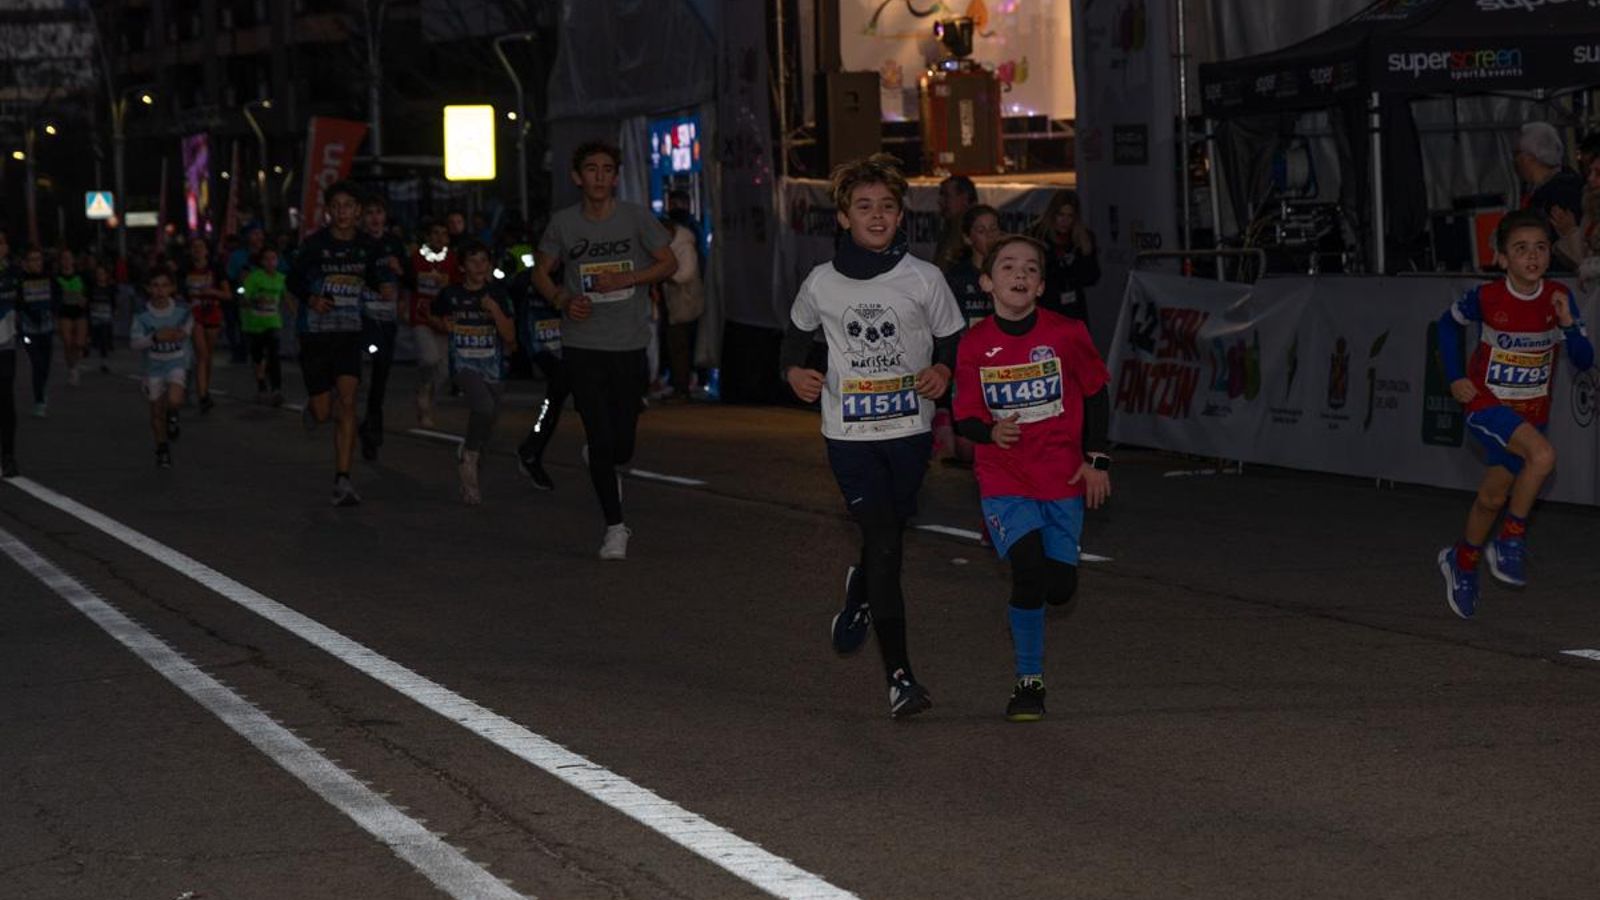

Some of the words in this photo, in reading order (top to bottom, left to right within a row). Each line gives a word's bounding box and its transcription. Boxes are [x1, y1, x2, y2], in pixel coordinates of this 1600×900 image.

[1387, 46, 1522, 78] superscreen
[844, 390, 917, 415] 11511
[986, 374, 1060, 403] 11487
